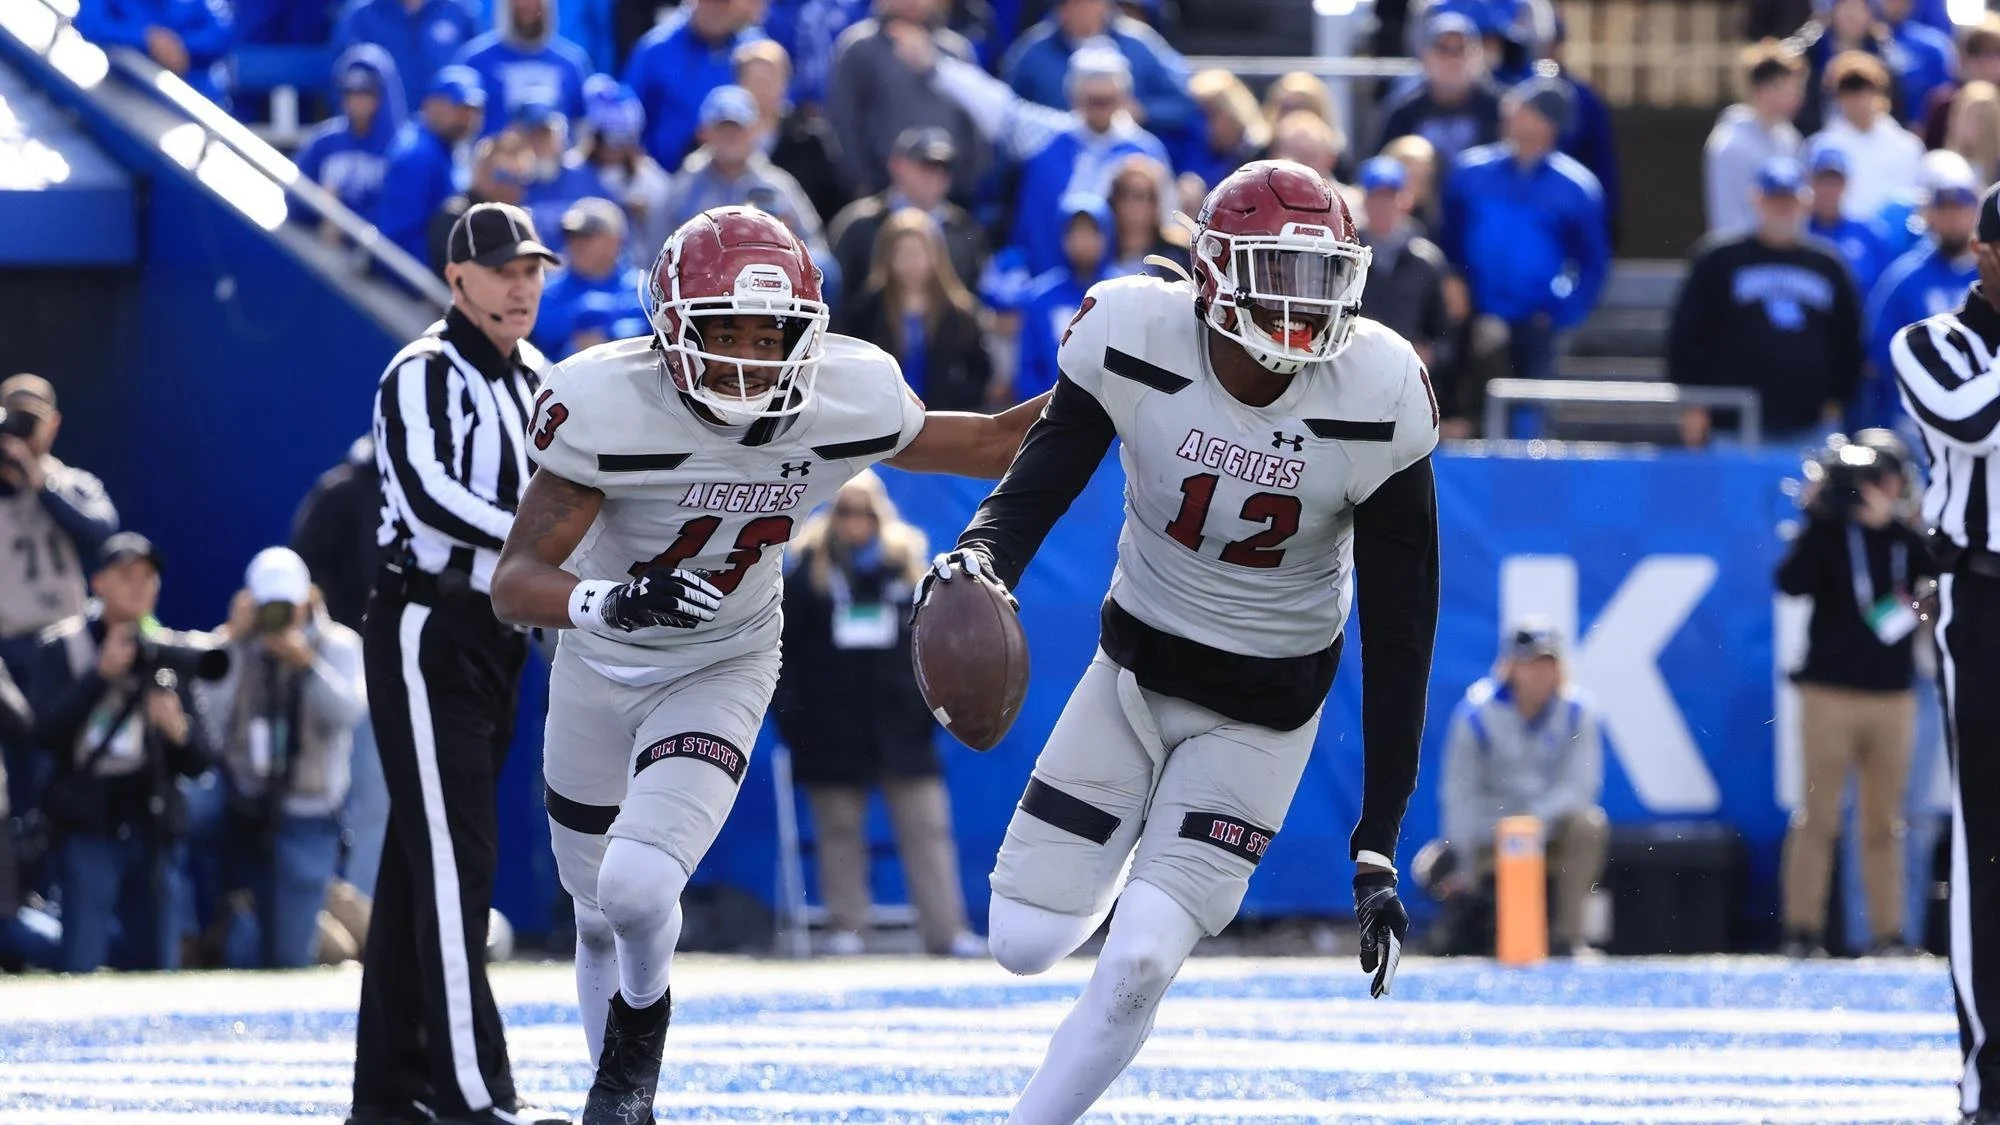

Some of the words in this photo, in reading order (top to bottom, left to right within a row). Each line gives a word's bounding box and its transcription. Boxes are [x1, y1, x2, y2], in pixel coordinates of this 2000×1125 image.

[528, 388, 570, 451] 13
[1176, 428, 1306, 490] AGGIES
[679, 482, 808, 513] AGGIES
[1164, 472, 1303, 569] 12
[627, 514, 795, 597] 13
[651, 740, 676, 760] NM
[682, 736, 739, 772] STATE
[1209, 820, 1244, 847] NM
